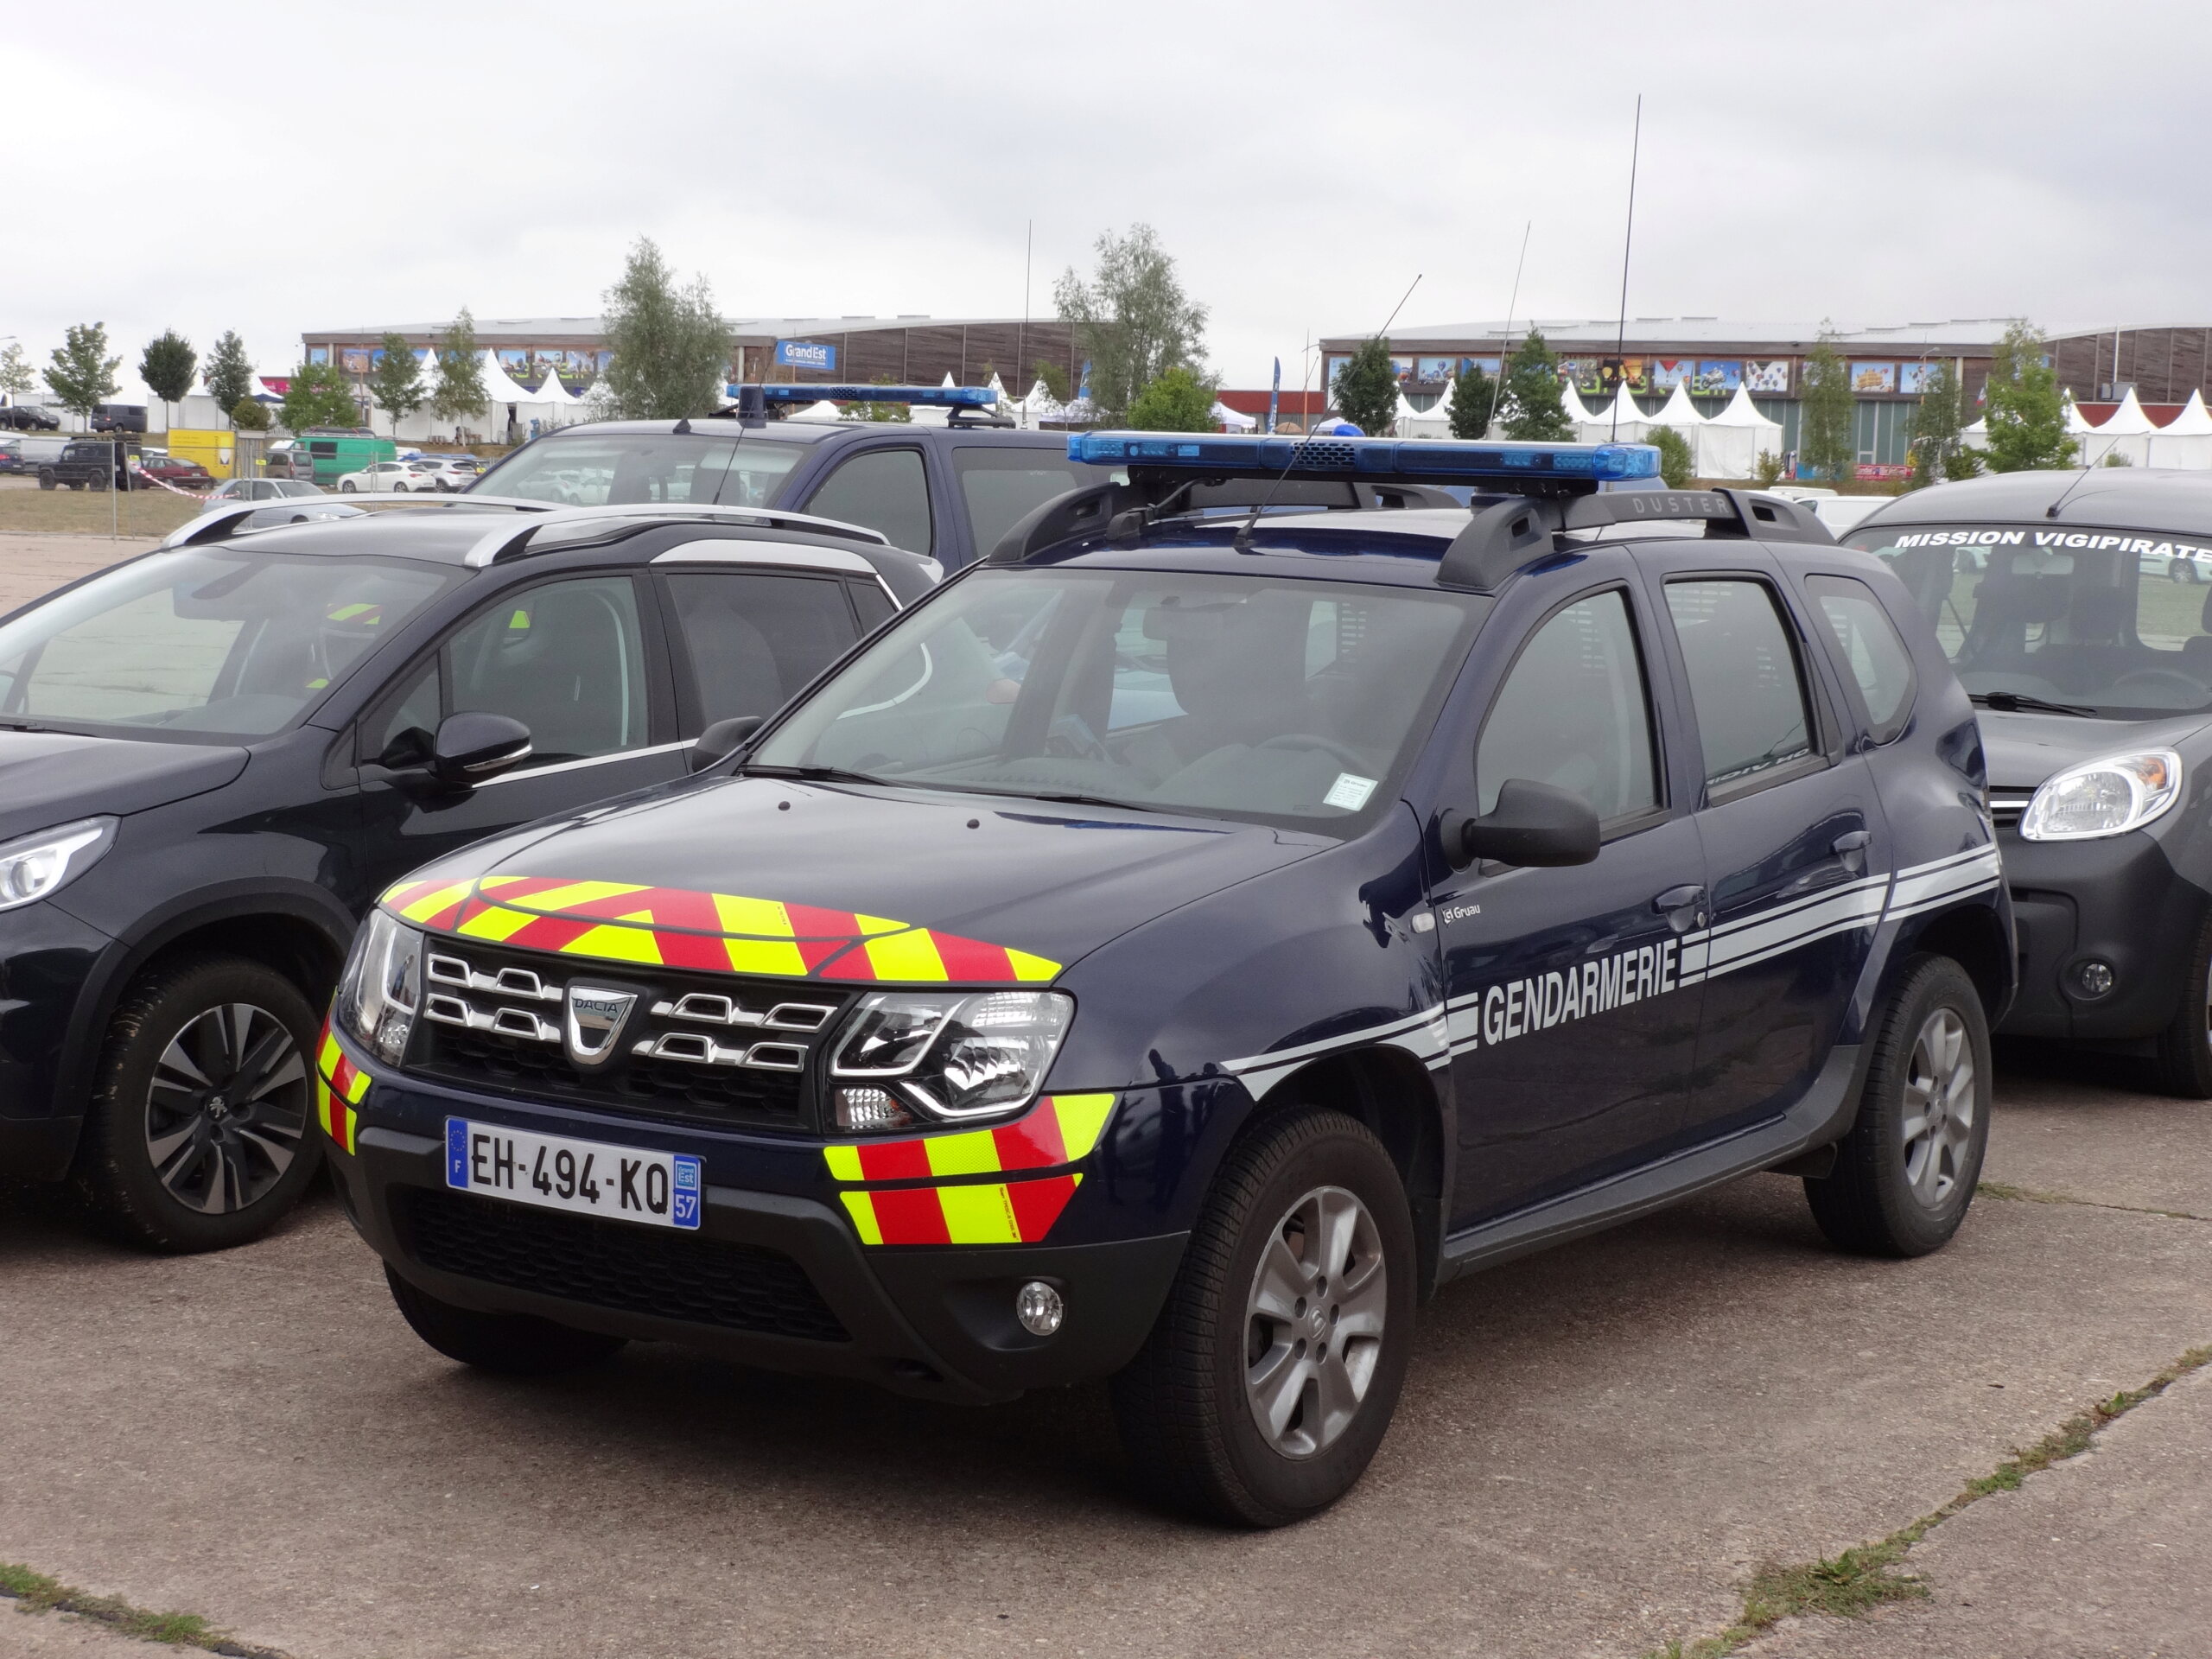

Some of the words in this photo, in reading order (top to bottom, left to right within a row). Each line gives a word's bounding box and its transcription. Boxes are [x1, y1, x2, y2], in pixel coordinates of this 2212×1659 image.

[1632, 497, 1729, 513] DUSTER
[1895, 531, 2026, 549] MISSION
[2034, 532, 2212, 563] VIGIPIRATE
[1453, 904, 1481, 918] Gruau
[1484, 938, 1677, 1046] GENDARMERIE
[575, 999, 618, 1013] DACIA
[454, 1160, 461, 1173] F
[473, 1133, 669, 1215] EH-494-KQ
[678, 1172, 694, 1184] Est
[676, 1194, 697, 1219] 57
